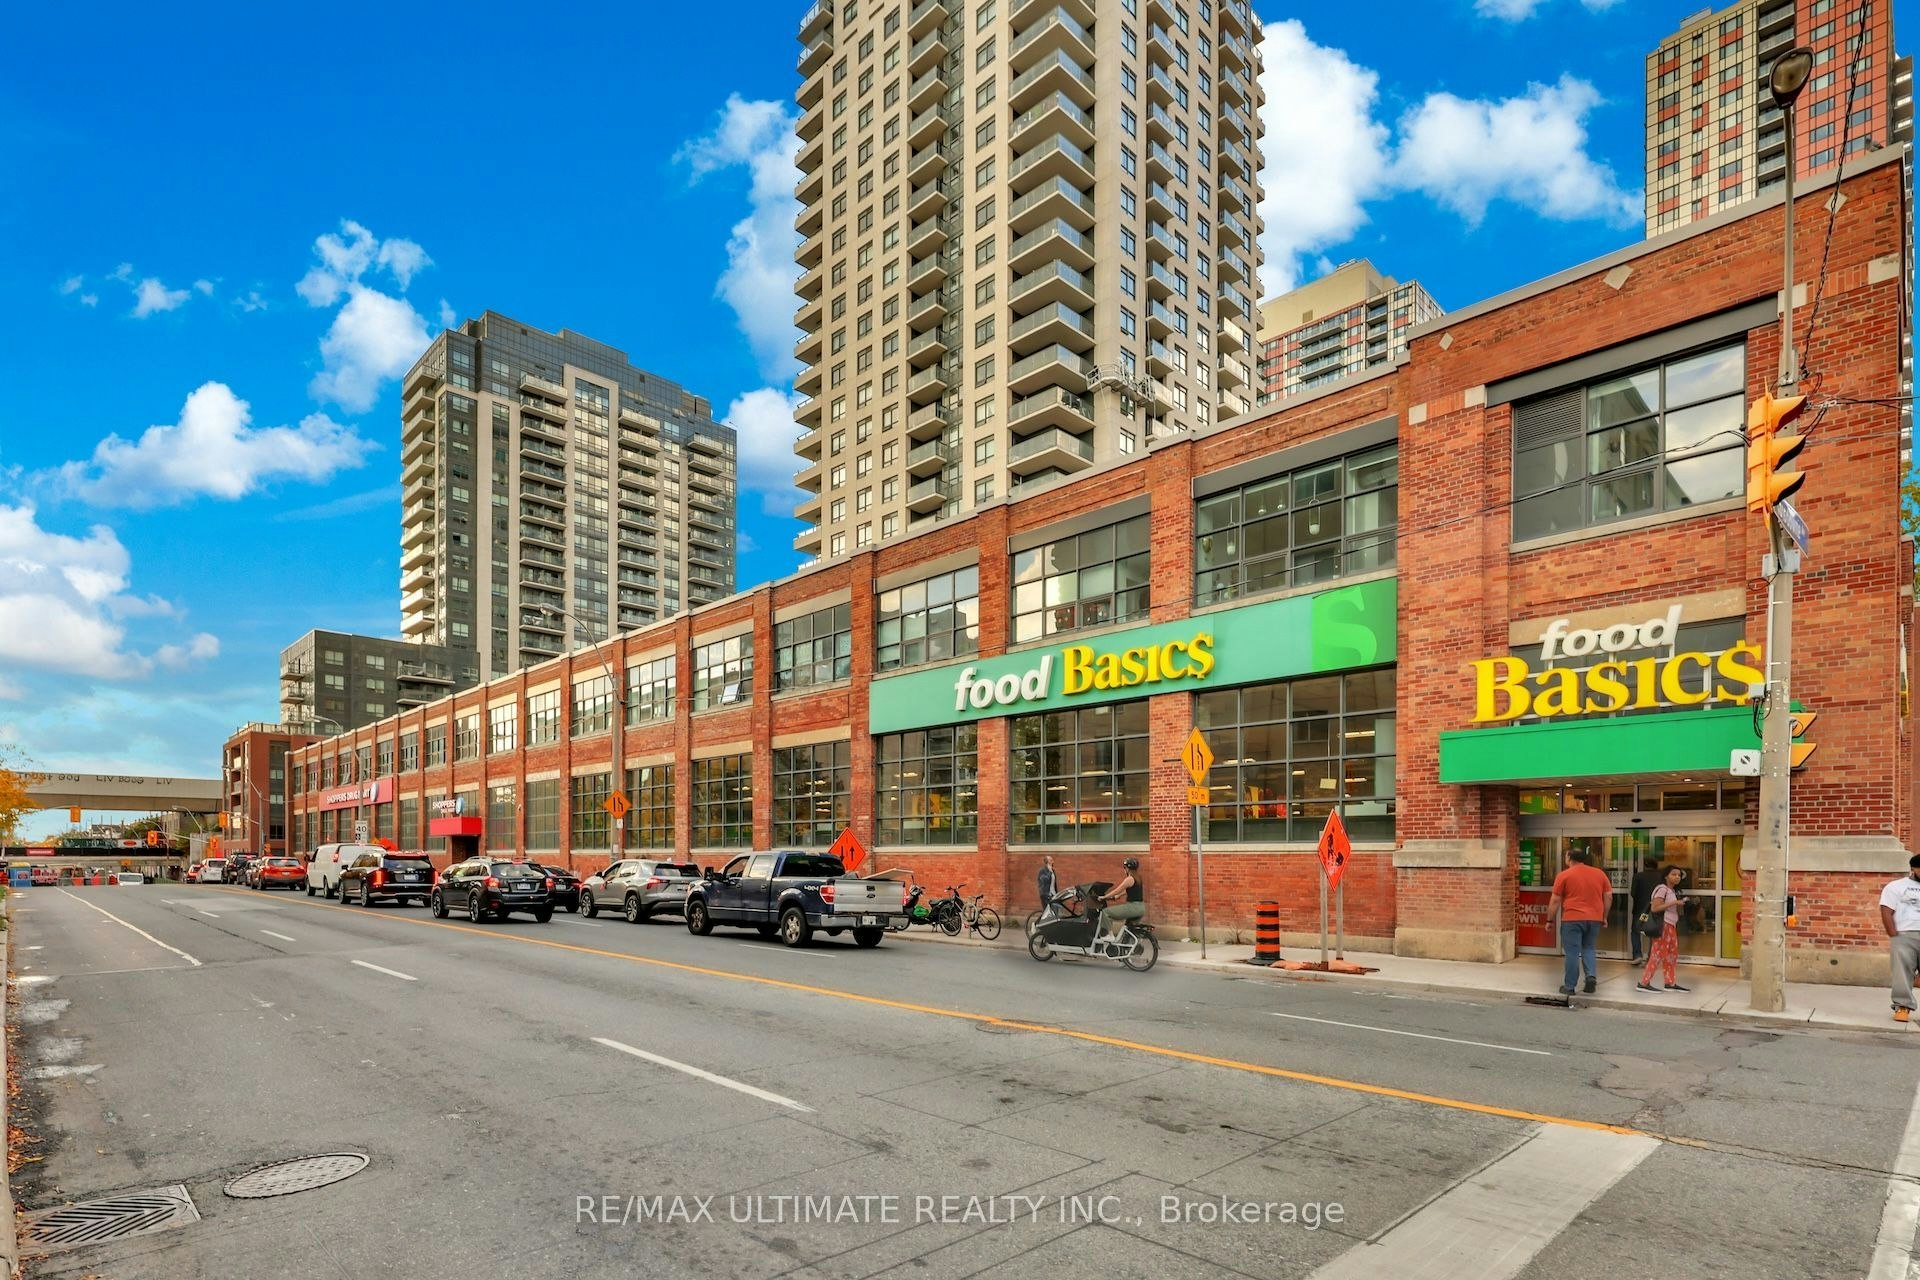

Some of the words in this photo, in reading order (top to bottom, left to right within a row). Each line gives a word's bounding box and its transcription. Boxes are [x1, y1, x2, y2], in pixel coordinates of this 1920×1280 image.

[1539, 603, 1684, 661] food
[953, 655, 1054, 711] food
[1191, 790, 1199, 800] 50
[356, 825, 367, 833] 40
